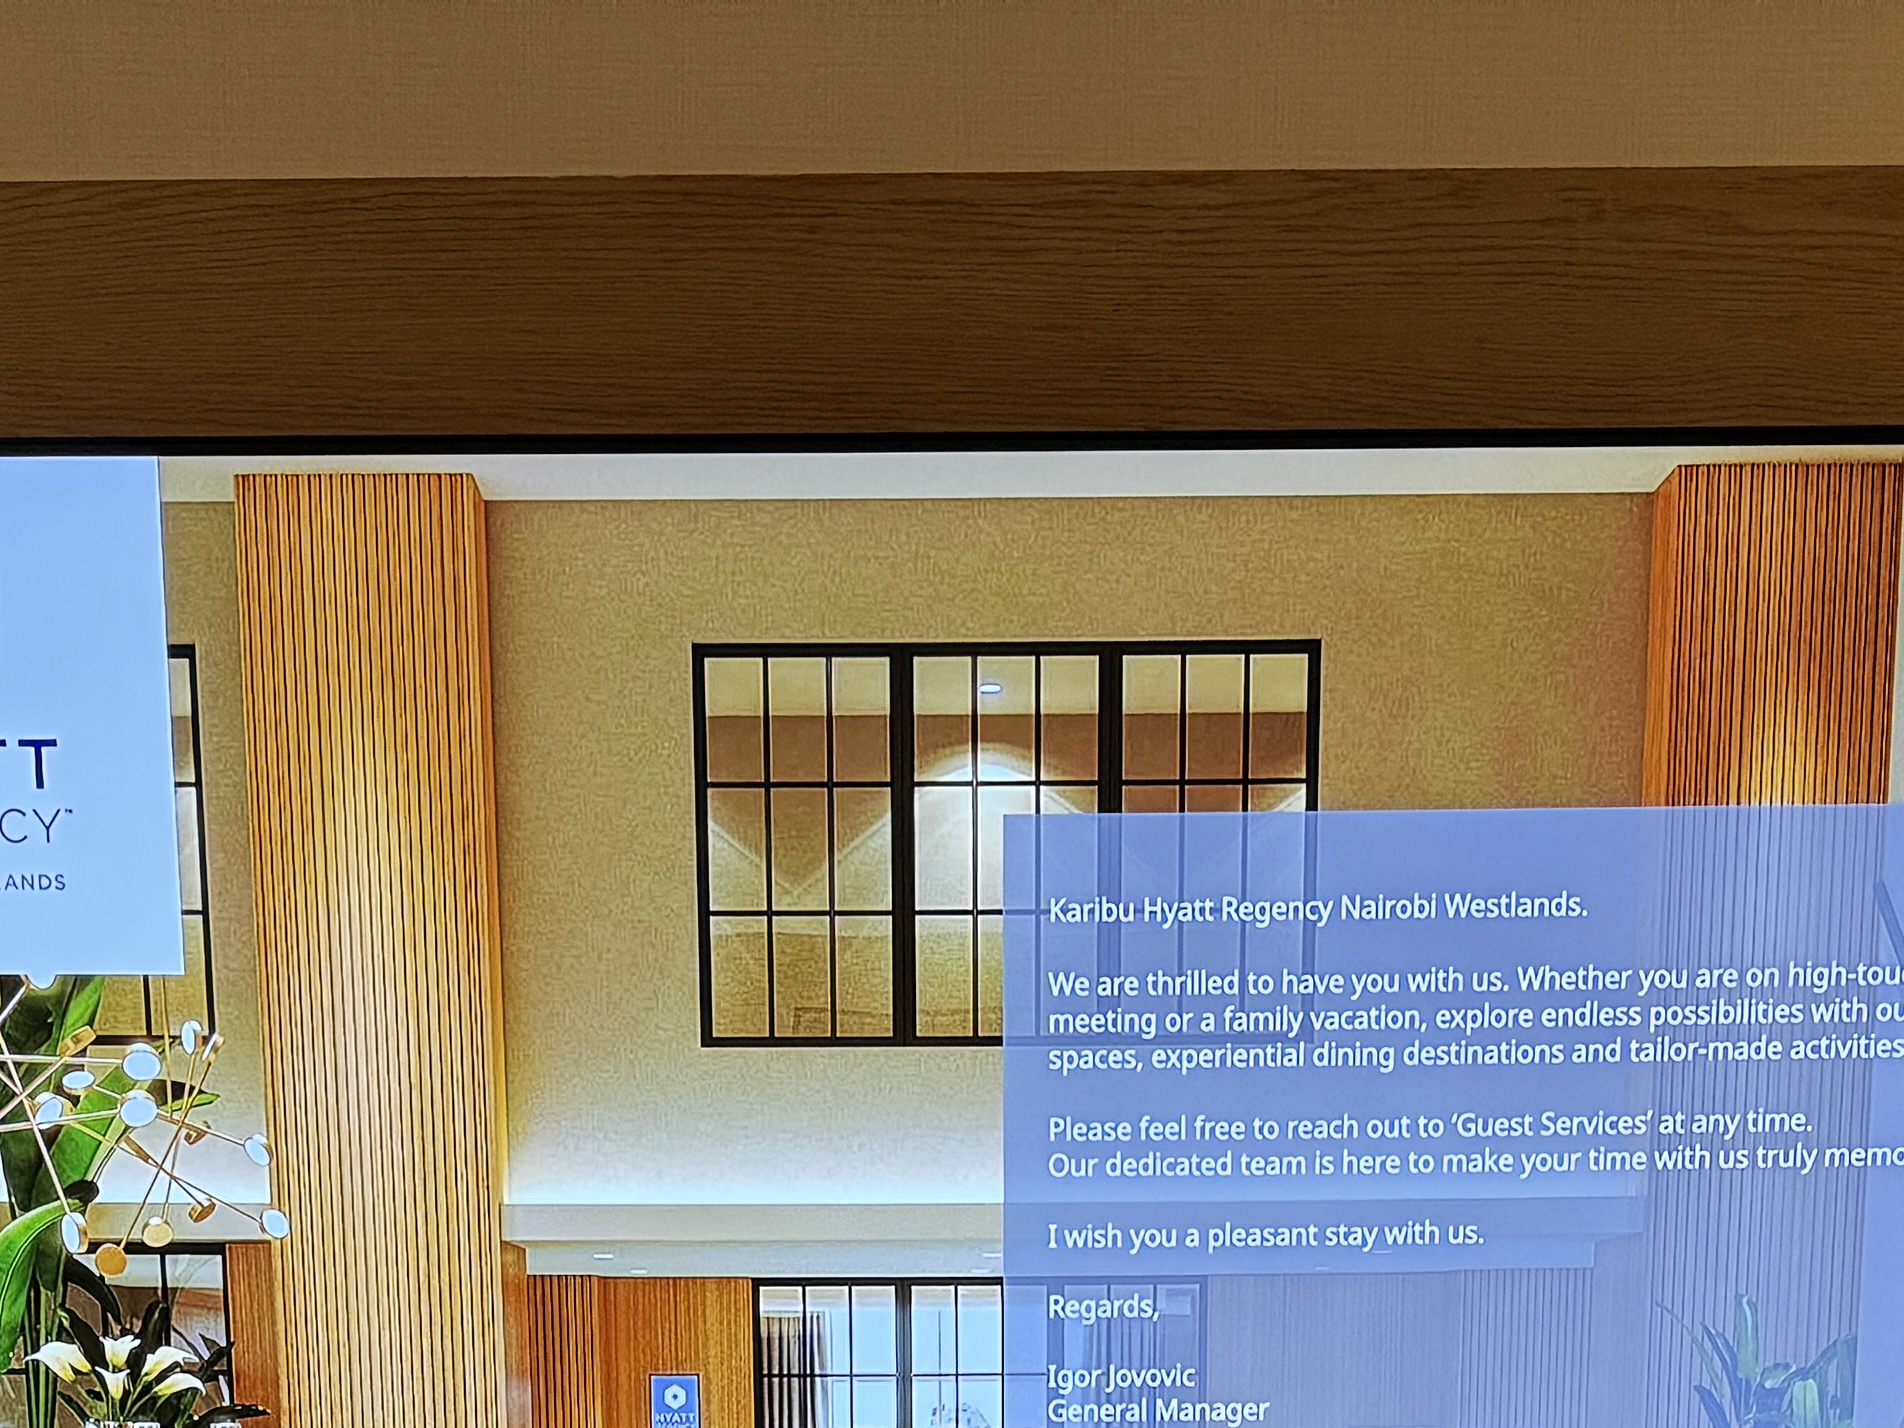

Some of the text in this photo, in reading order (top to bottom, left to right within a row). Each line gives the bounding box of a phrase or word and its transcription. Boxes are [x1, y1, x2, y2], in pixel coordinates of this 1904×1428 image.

[1048, 890, 1588, 929] Karibu Hyatt Regency Nairobi Westlands.
[1047, 971, 1090, 997] We
[1096, 975, 1139, 997] are
[1145, 968, 1240, 997] thrilled
[1246, 971, 1275, 995] to
[1282, 968, 1345, 995] have
[1350, 973, 1400, 1001] you
[1406, 966, 1464, 993] with
[1472, 971, 1510, 992] us.
[1517, 963, 1633, 991] Whether
[1638, 969, 1689, 998] you
[1695, 968, 1740, 990] are
[1745, 967, 1780, 989] on
[1049, 1007, 1157, 1039] meeting
[1165, 1012, 1194, 1033] or
[1200, 1012, 1216, 1033] a
[1223, 1004, 1304, 1038] family
[1309, 1004, 1428, 1033] vacation,
[1435, 1001, 1534, 1037] explore
[1540, 999, 1642, 1028] endless
[1650, 996, 1804, 1033] possibilities
[1810, 995, 1868, 1024] with
[1048, 1049, 1144, 1077] spaces,
[1151, 1042, 1305, 1076] experiential
[1312, 1040, 1395, 1074] dining
[1402, 1038, 1565, 1066] destinations
[1571, 1035, 1622, 1064] and
[1629, 1033, 1783, 1063] tailor-made
[1049, 1116, 1133, 1142] Please
[1139, 1114, 1187, 1141] feel
[1193, 1114, 1246, 1141] free
[1252, 1117, 1280, 1140] to
[1287, 1113, 1359, 1140] reach
[1366, 1115, 1411, 1139] out
[1417, 1115, 1445, 1138] to
[1658, 1114, 1685, 1135] at
[1691, 1114, 1742, 1141] any
[1745, 1107, 1813, 1134] time.
[1048, 1152, 1099, 1178] Our
[1105, 1149, 1232, 1177] dedicated
[1240, 1153, 1306, 1176] team
[1314, 1149, 1335, 1175] is
[1342, 1148, 1401, 1175] here
[1408, 1151, 1435, 1174] to
[1442, 1146, 1514, 1173] make
[1519, 1152, 1583, 1179] your
[1588, 1145, 1648, 1171] time
[1653, 1142, 1711, 1171] with
[1718, 1149, 1750, 1170] us
[1756, 1142, 1818, 1174] truly
[1048, 1219, 1485, 1255] I wish you a pleasant stay with us.
[1048, 1292, 1159, 1326] Regards,
[1047, 1362, 1198, 1395] Igor Jovovic
[654, 1412, 696, 1423] HYATT
[1047, 1398, 1271, 1428] General Manager
